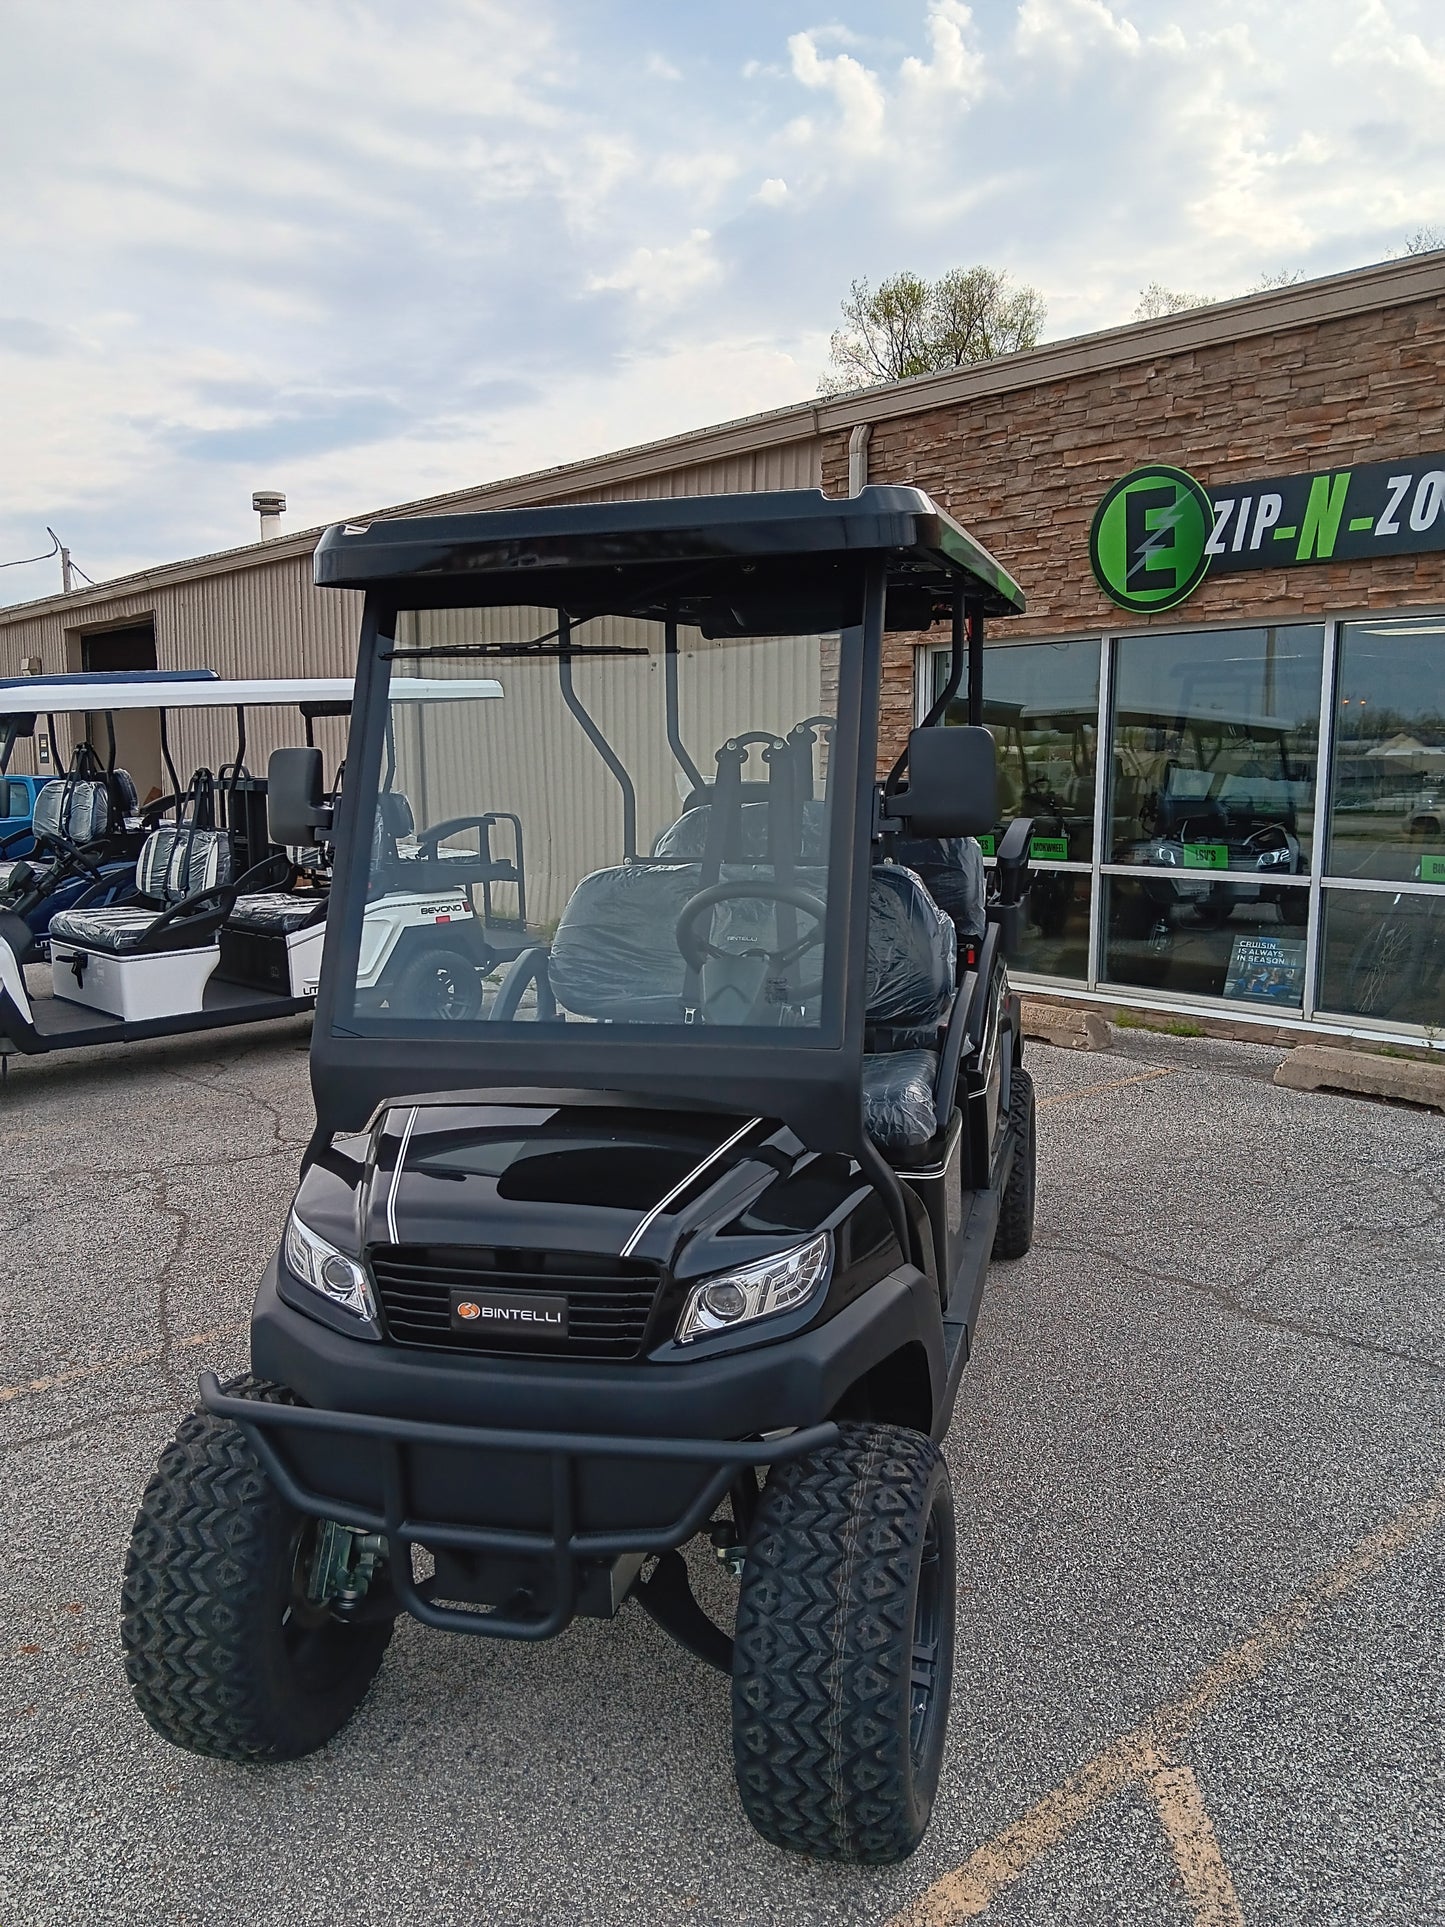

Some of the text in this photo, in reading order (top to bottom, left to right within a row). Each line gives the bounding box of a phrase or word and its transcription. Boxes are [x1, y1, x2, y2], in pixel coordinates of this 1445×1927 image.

[1204, 471, 1445, 561] ZIP-N-ZO
[1126, 485, 1177, 593] E
[421, 904, 462, 914] BEYOND
[1240, 940, 1276, 950] CRUISIN
[1248, 949, 1284, 958] ALWAYS
[1248, 955, 1285, 965] SEASON
[481, 1306, 561, 1323] BINTELLI
